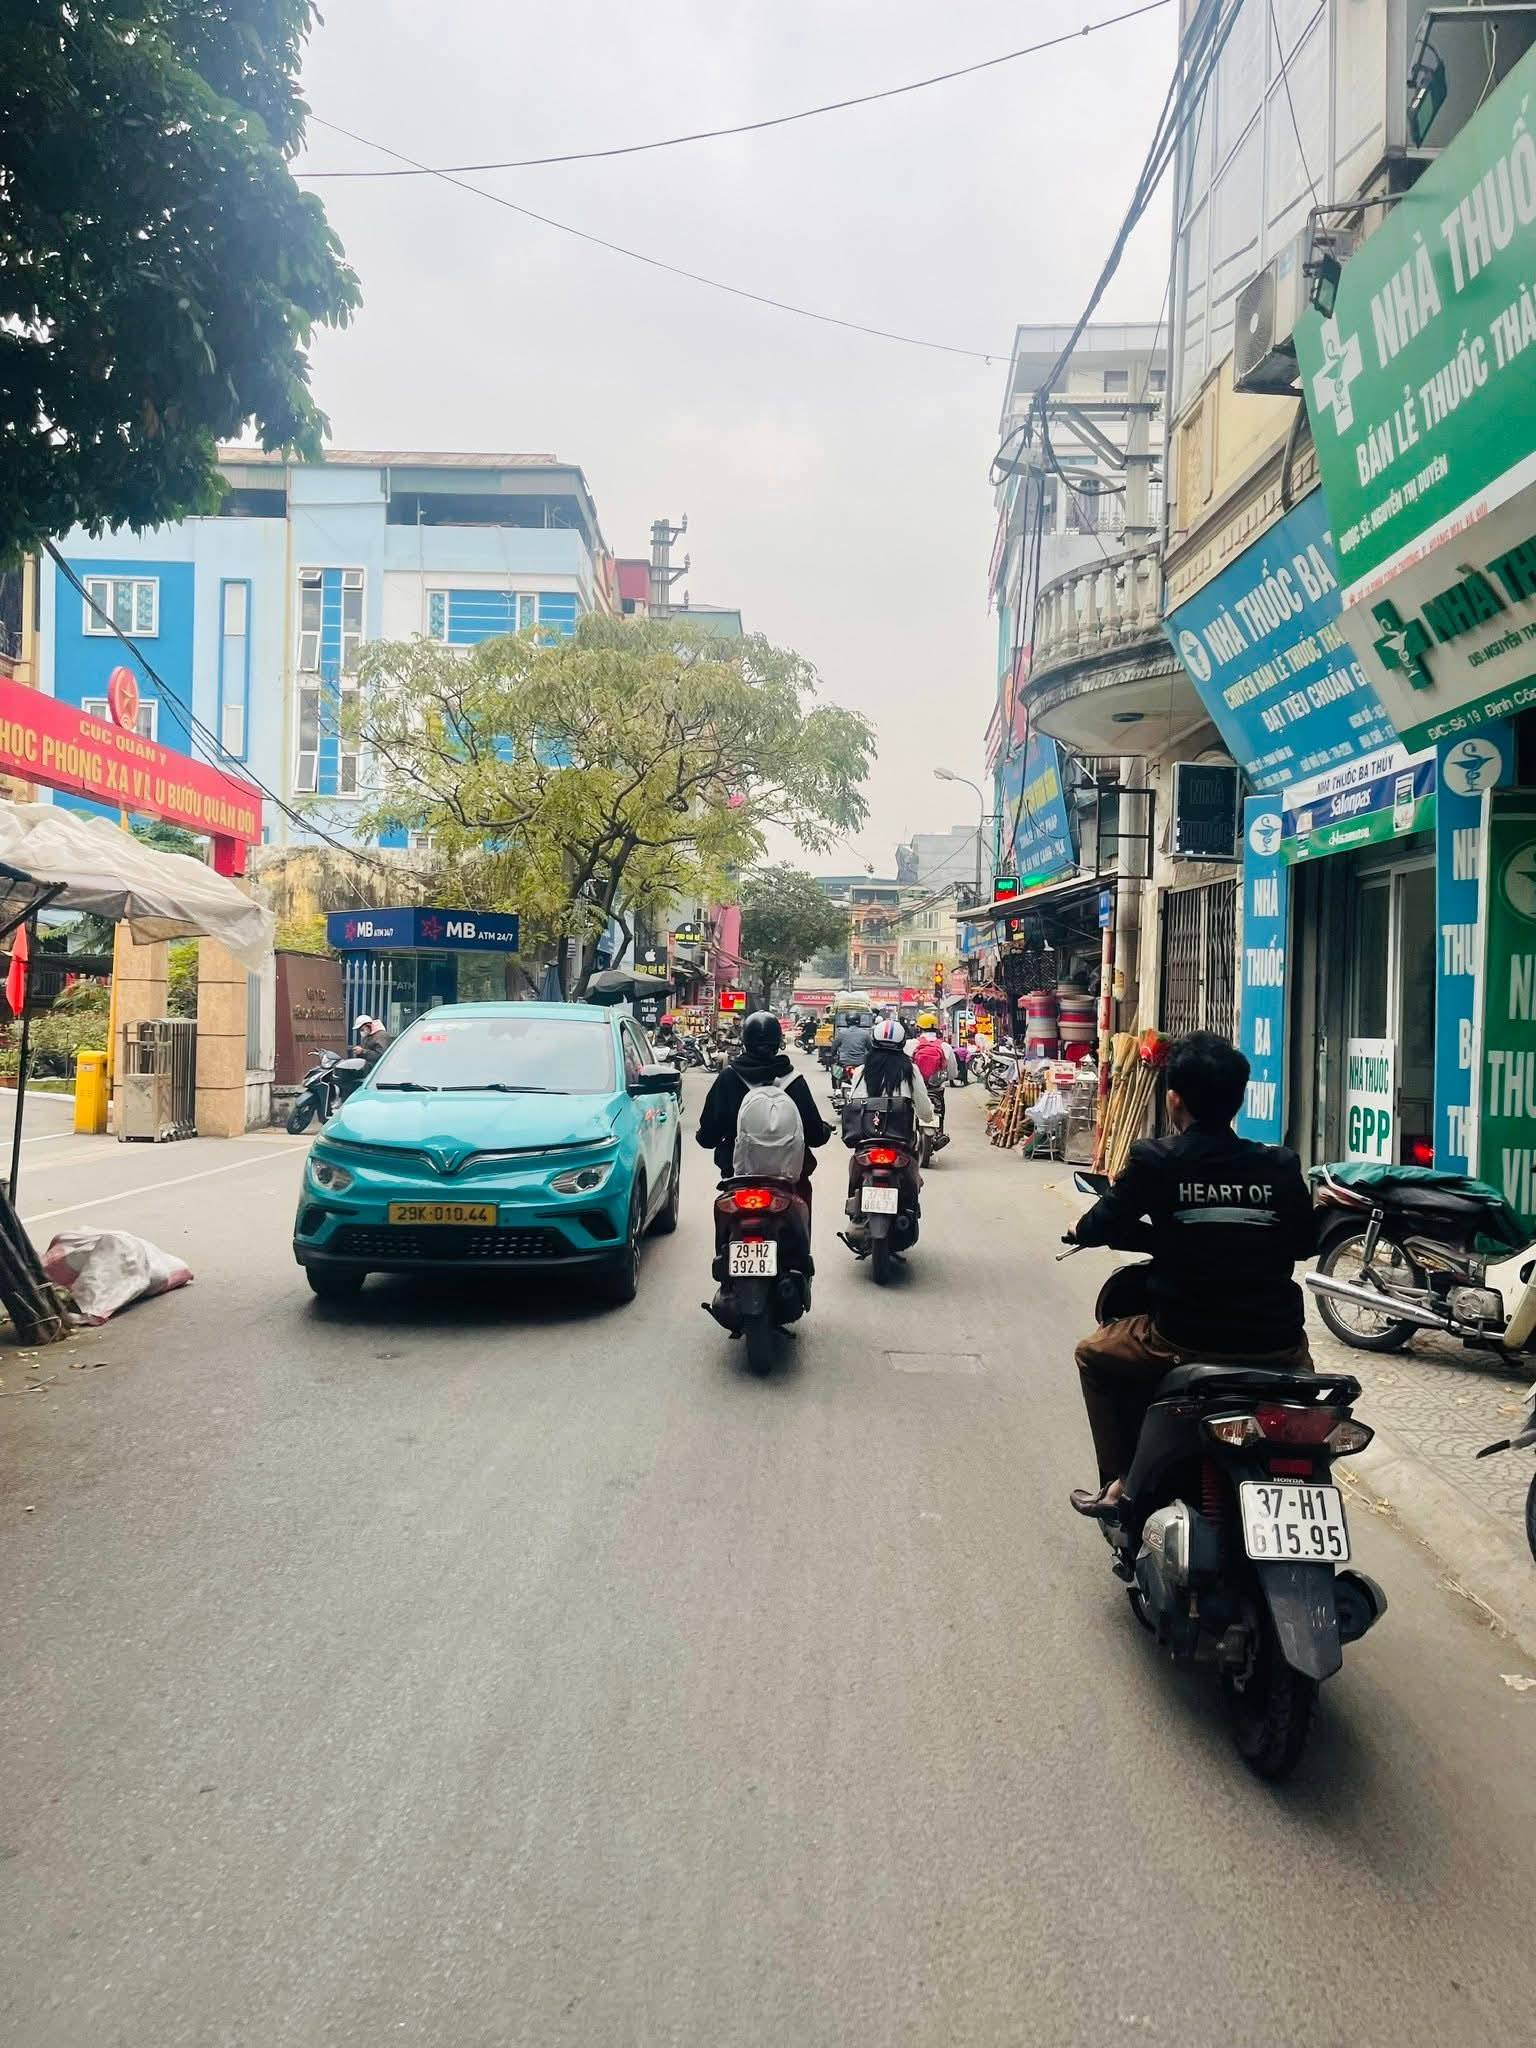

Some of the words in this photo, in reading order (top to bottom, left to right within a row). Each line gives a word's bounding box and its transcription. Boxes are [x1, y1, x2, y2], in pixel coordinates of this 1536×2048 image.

[1371, 231, 1442, 369] NHÀ
[1356, 423, 1394, 487] BÁN
[1394, 384, 1419, 455] LẺ
[1419, 328, 1488, 431] THUỐC
[1203, 604, 1249, 666] NHÀ
[1234, 558, 1303, 641] THUỐC
[1292, 544, 1338, 603] BA
[1421, 563, 1507, 643] NHÀ
[1284, 631, 1321, 673] THUỐC
[1329, 788, 1372, 818] Salonpas
[1253, 869, 1279, 917] NHÀ
[357, 921, 374, 938] MB
[446, 921, 476, 939] MB
[478, 931, 496, 941] ATM
[497, 932, 513, 942] 24/7
[1246, 934, 1284, 987] THUỐC
[1255, 1017, 1271, 1056] BA
[1349, 1048, 1363, 1091] NHÀ
[1365, 1044, 1389, 1095] THUỐC
[1246, 1068, 1276, 1121] THỦY
[1349, 1105, 1391, 1157] GPP
[1179, 1183, 1243, 1203] HEART
[1248, 1184, 1273, 1204] OF
[736, 1244, 769, 1260] 29-H2
[1256, 1488, 1327, 1520] 37-H1
[1252, 1523, 1341, 1556] 615.95
